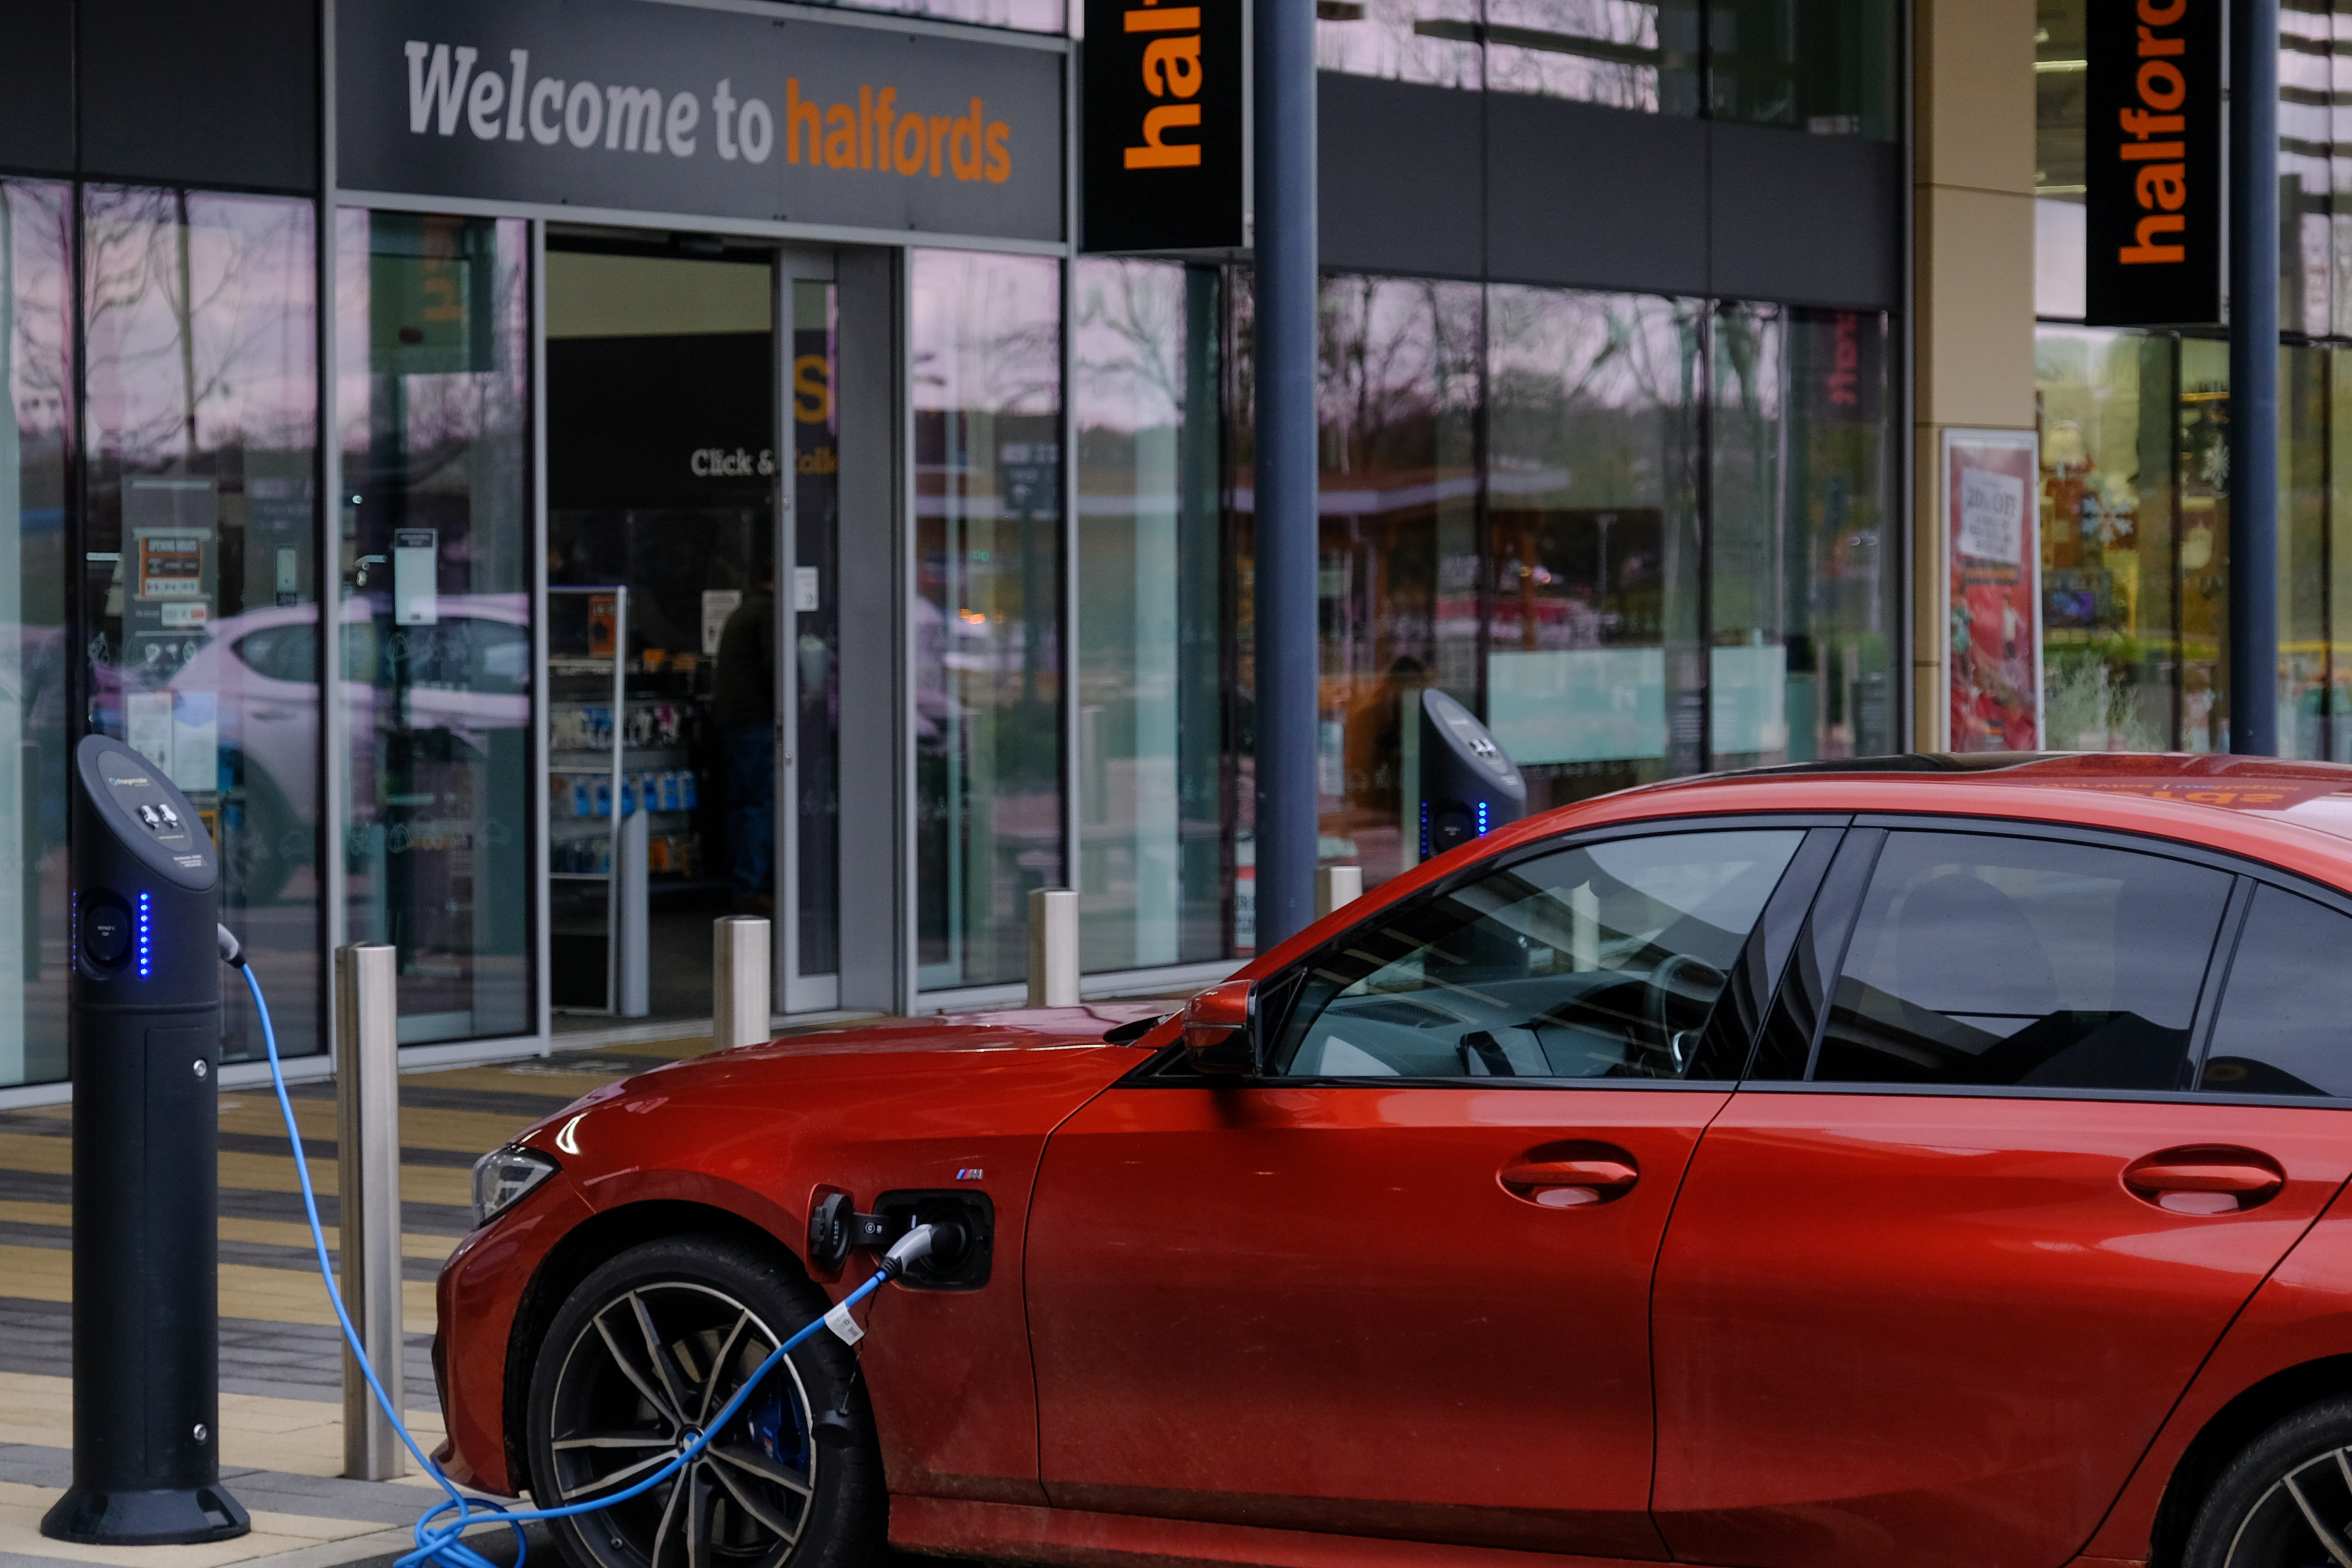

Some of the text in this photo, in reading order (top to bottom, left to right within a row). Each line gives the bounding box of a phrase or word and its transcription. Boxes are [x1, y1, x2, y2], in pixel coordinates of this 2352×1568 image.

[404, 40, 1012, 184] Welcome to halfords
[1123, 0, 1203, 170] hal
[691, 447, 754, 477] Click
